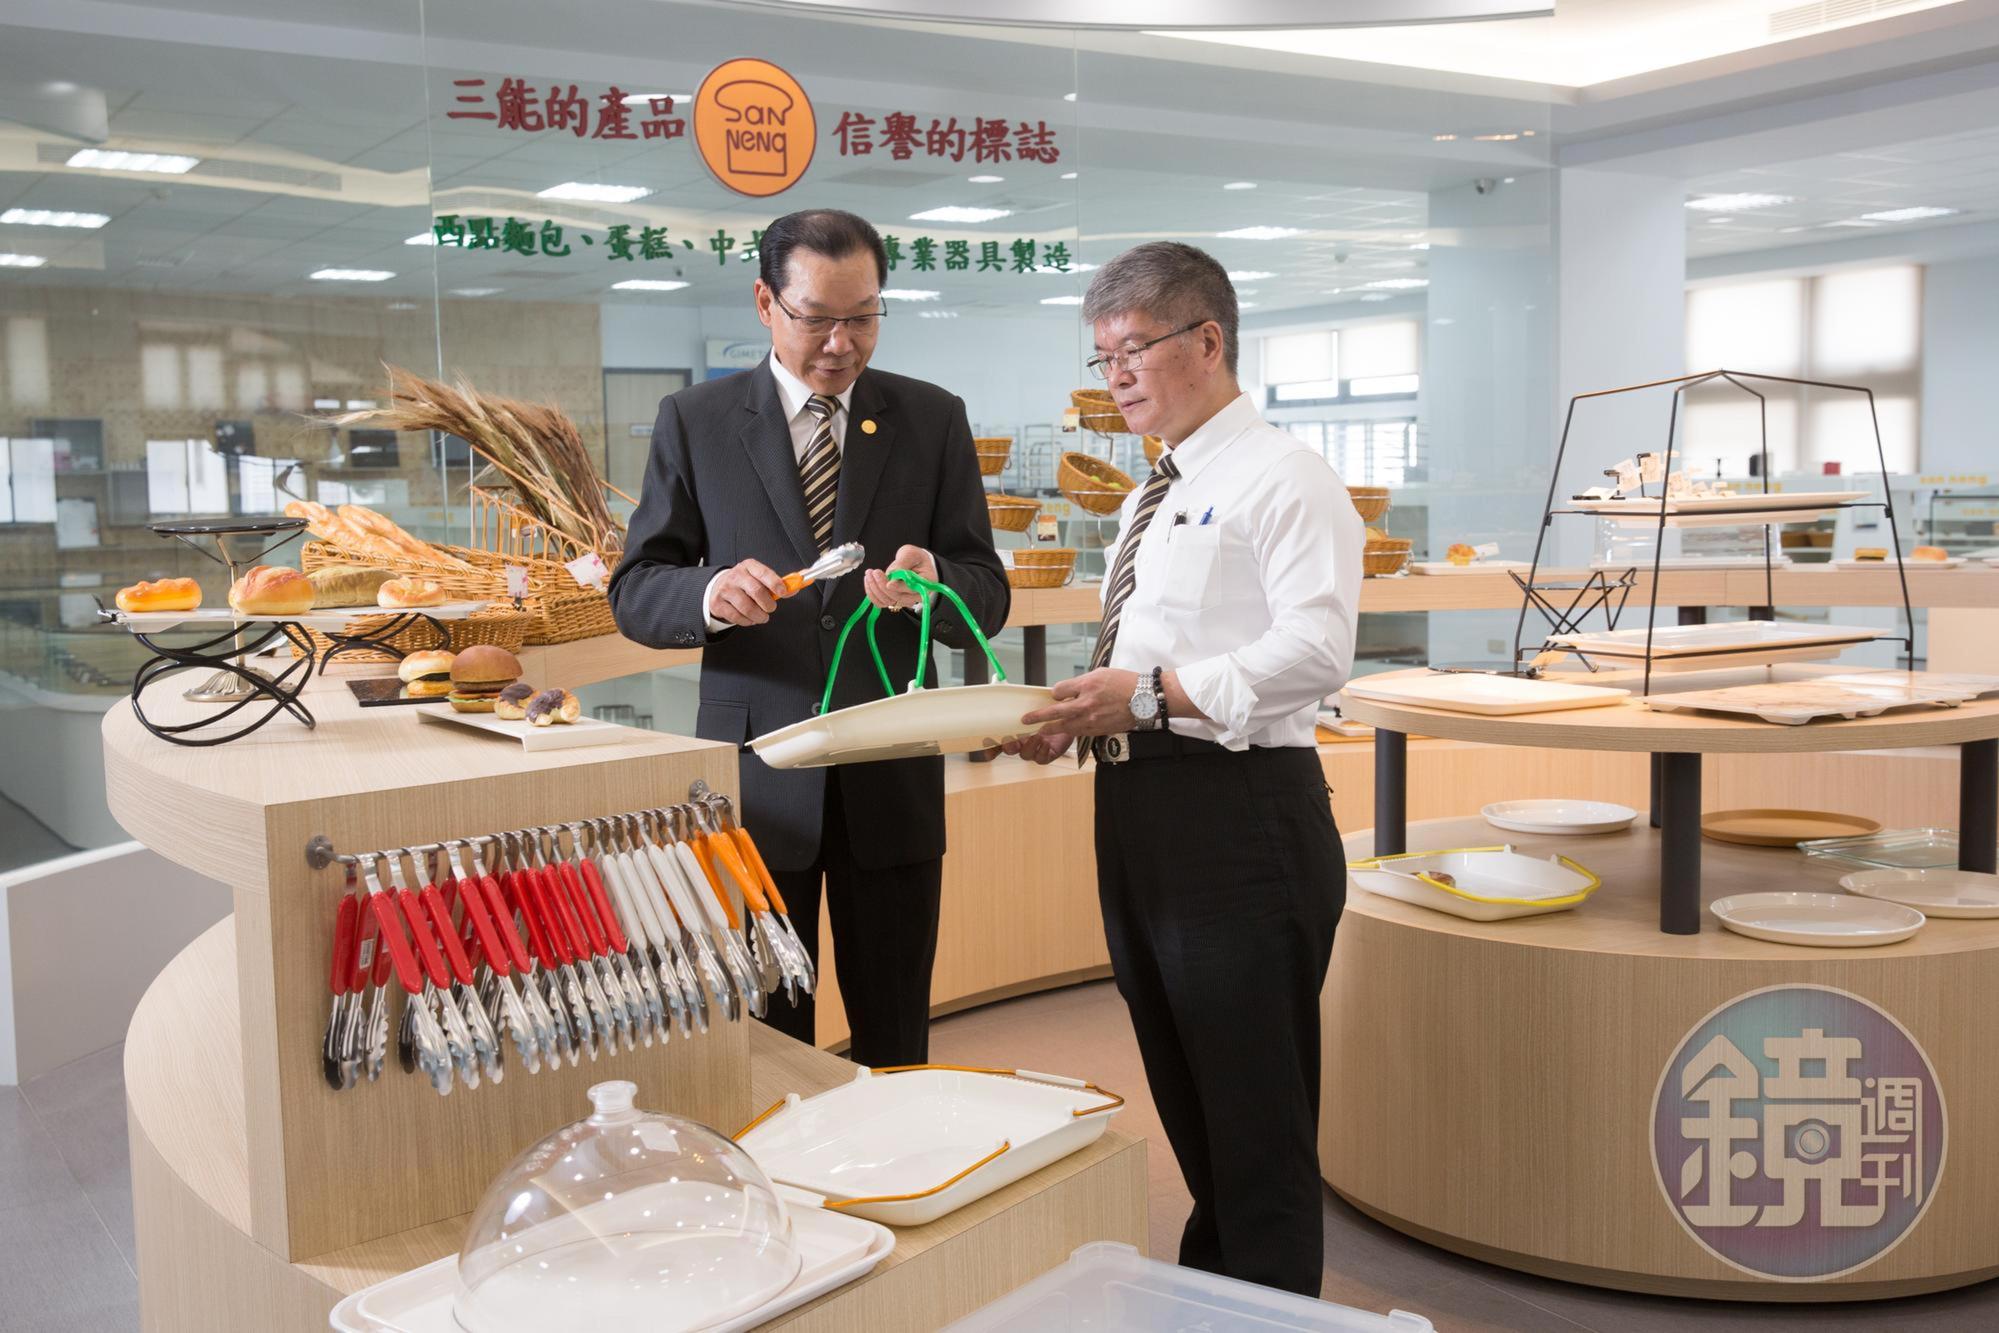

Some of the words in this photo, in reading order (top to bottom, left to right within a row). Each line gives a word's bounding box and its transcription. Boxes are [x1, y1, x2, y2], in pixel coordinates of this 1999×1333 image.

[447, 77, 686, 140] 三能的產品
[833, 111, 1060, 164] 信譽的標誌
[883, 234, 1072, 273] 專業器具製造
